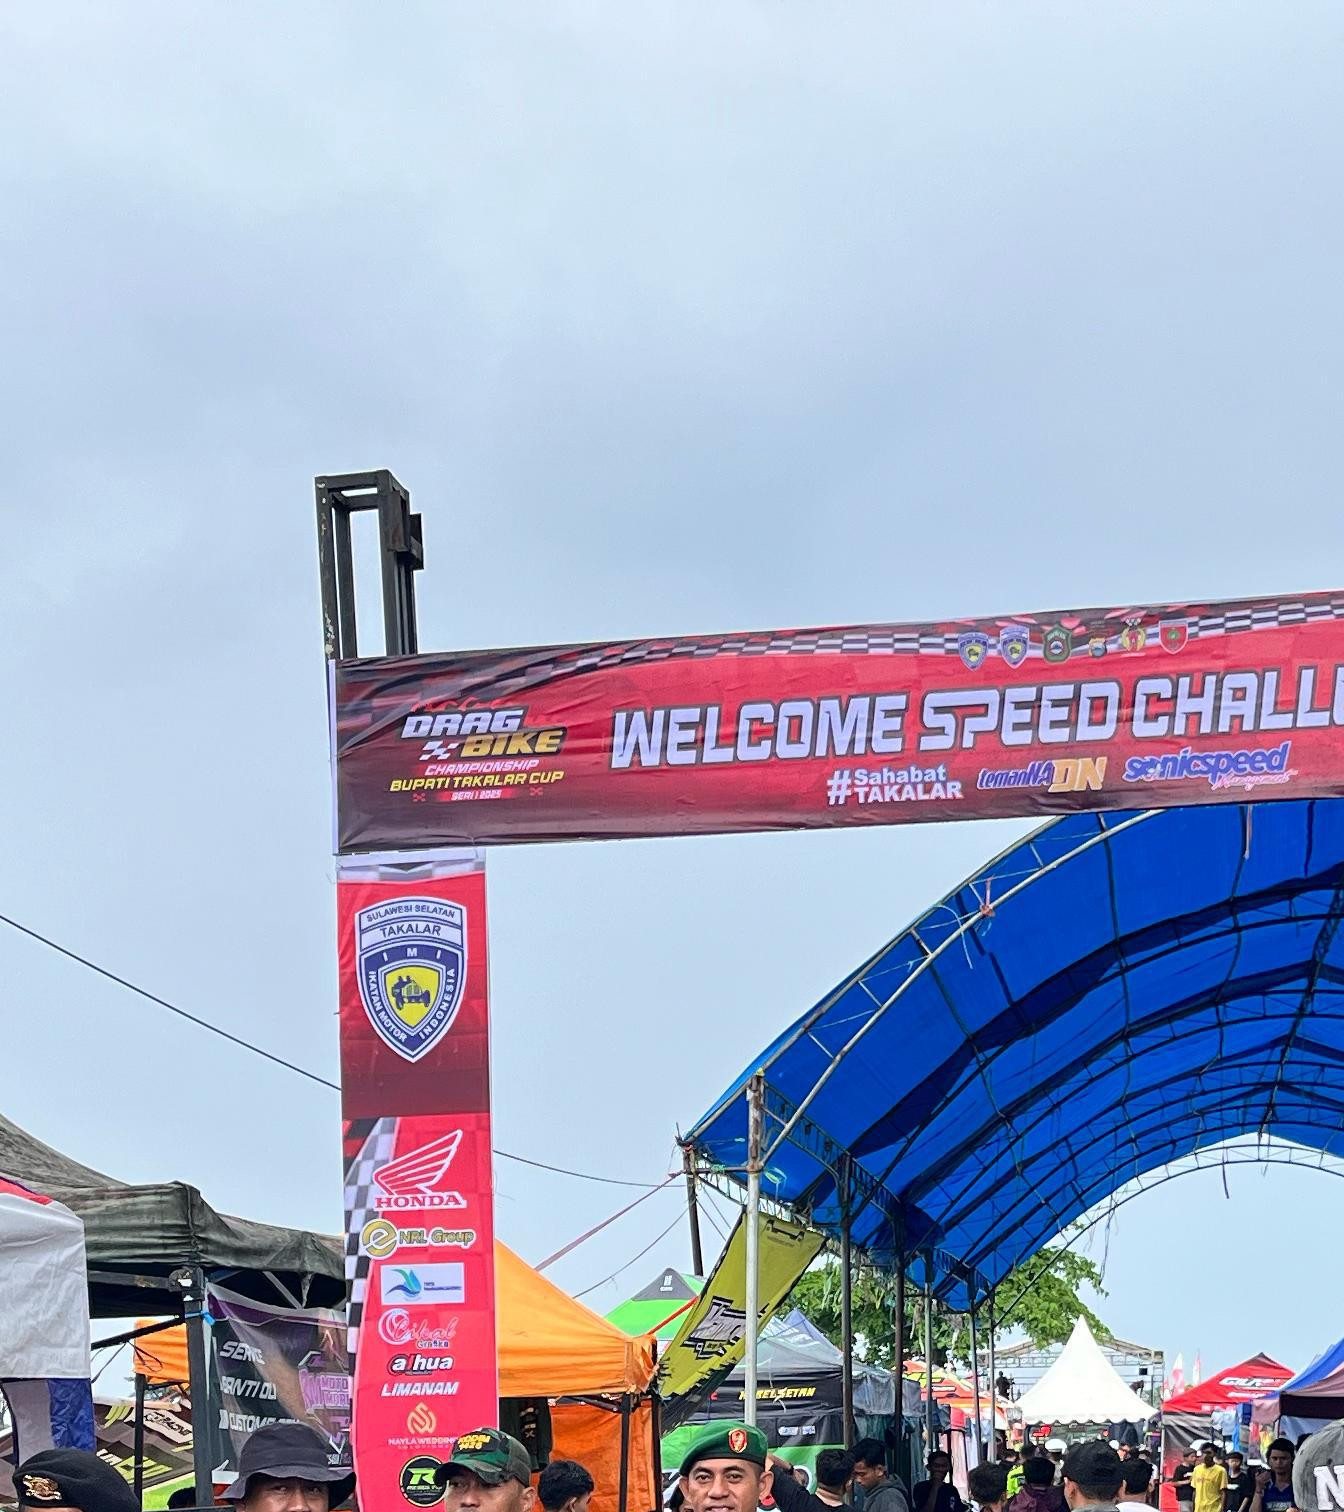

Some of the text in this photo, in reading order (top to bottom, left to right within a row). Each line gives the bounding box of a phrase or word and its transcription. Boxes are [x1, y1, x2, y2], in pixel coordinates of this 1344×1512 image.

[401, 710, 524, 739] DRAG
[612, 693, 908, 770] WELCOME
[918, 680, 1136, 753] SPEED
[460, 730, 563, 758] BIKE
[425, 759, 539, 776] CHAMPIONSHIP
[1122, 741, 1292, 787] sonicspeed
[389, 771, 564, 792] BUPATI TAKALAR CUP
[854, 782, 963, 804] TAKALAR
[367, 904, 455, 923] SULAWESI SELATAN
[380, 923, 442, 938] TAKALAR
[368, 970, 382, 1014] IKATAN
[418, 968, 456, 1040] INDONESIA
[378, 1011, 408, 1043] MOTOR
[374, 1195, 461, 1209] HONDA
[431, 1230, 474, 1246] Group
[381, 1382, 459, 1397] LIMANAM
[388, 1438, 417, 1446] NAYLA
